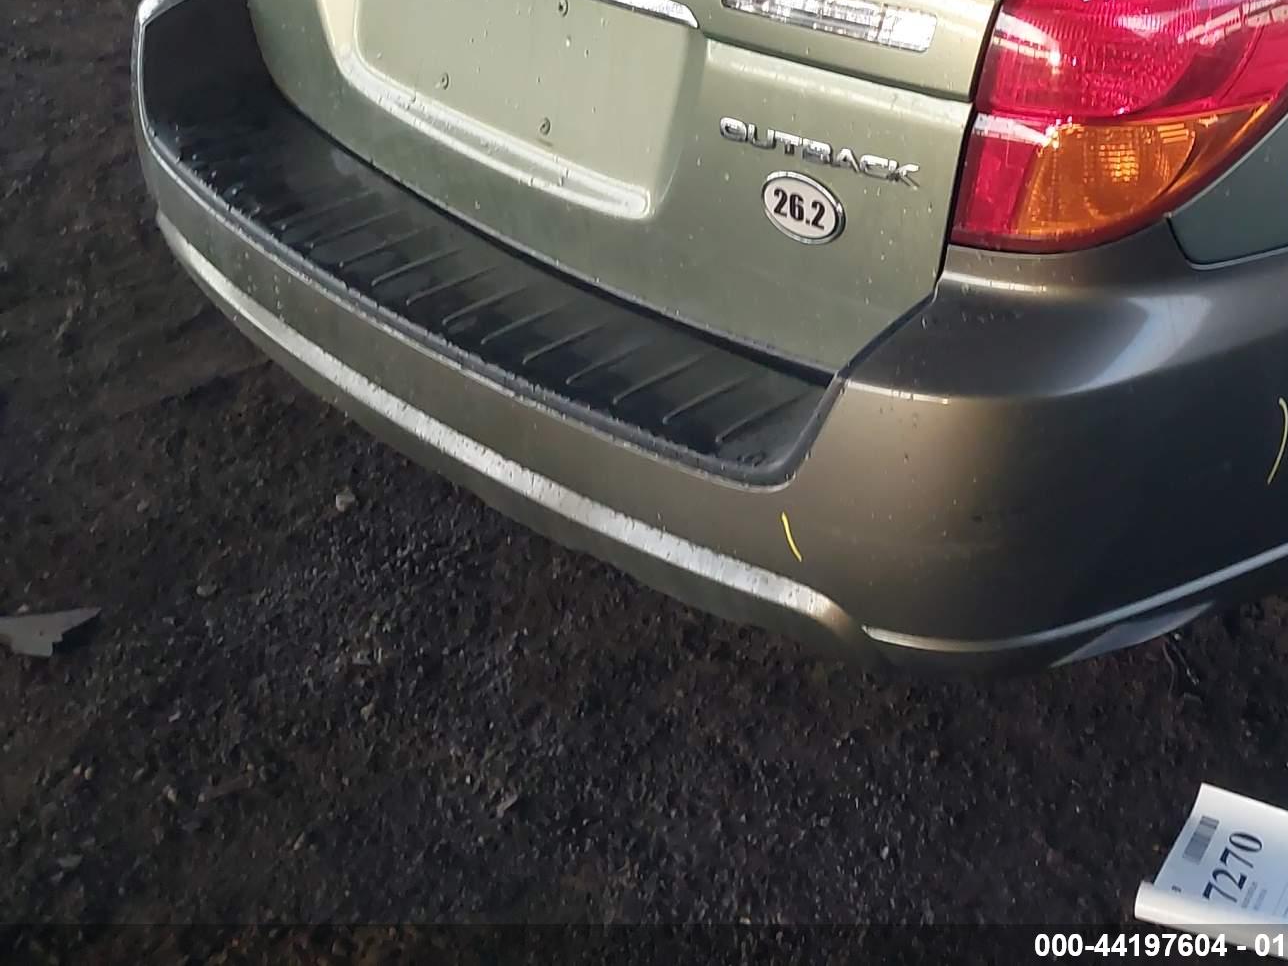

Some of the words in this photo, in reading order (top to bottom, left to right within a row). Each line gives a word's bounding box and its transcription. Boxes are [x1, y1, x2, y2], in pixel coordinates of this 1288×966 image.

[720, 116, 921, 187] OUTBACK
[773, 187, 826, 231] 26.2
[1202, 831, 1263, 904] 7270
